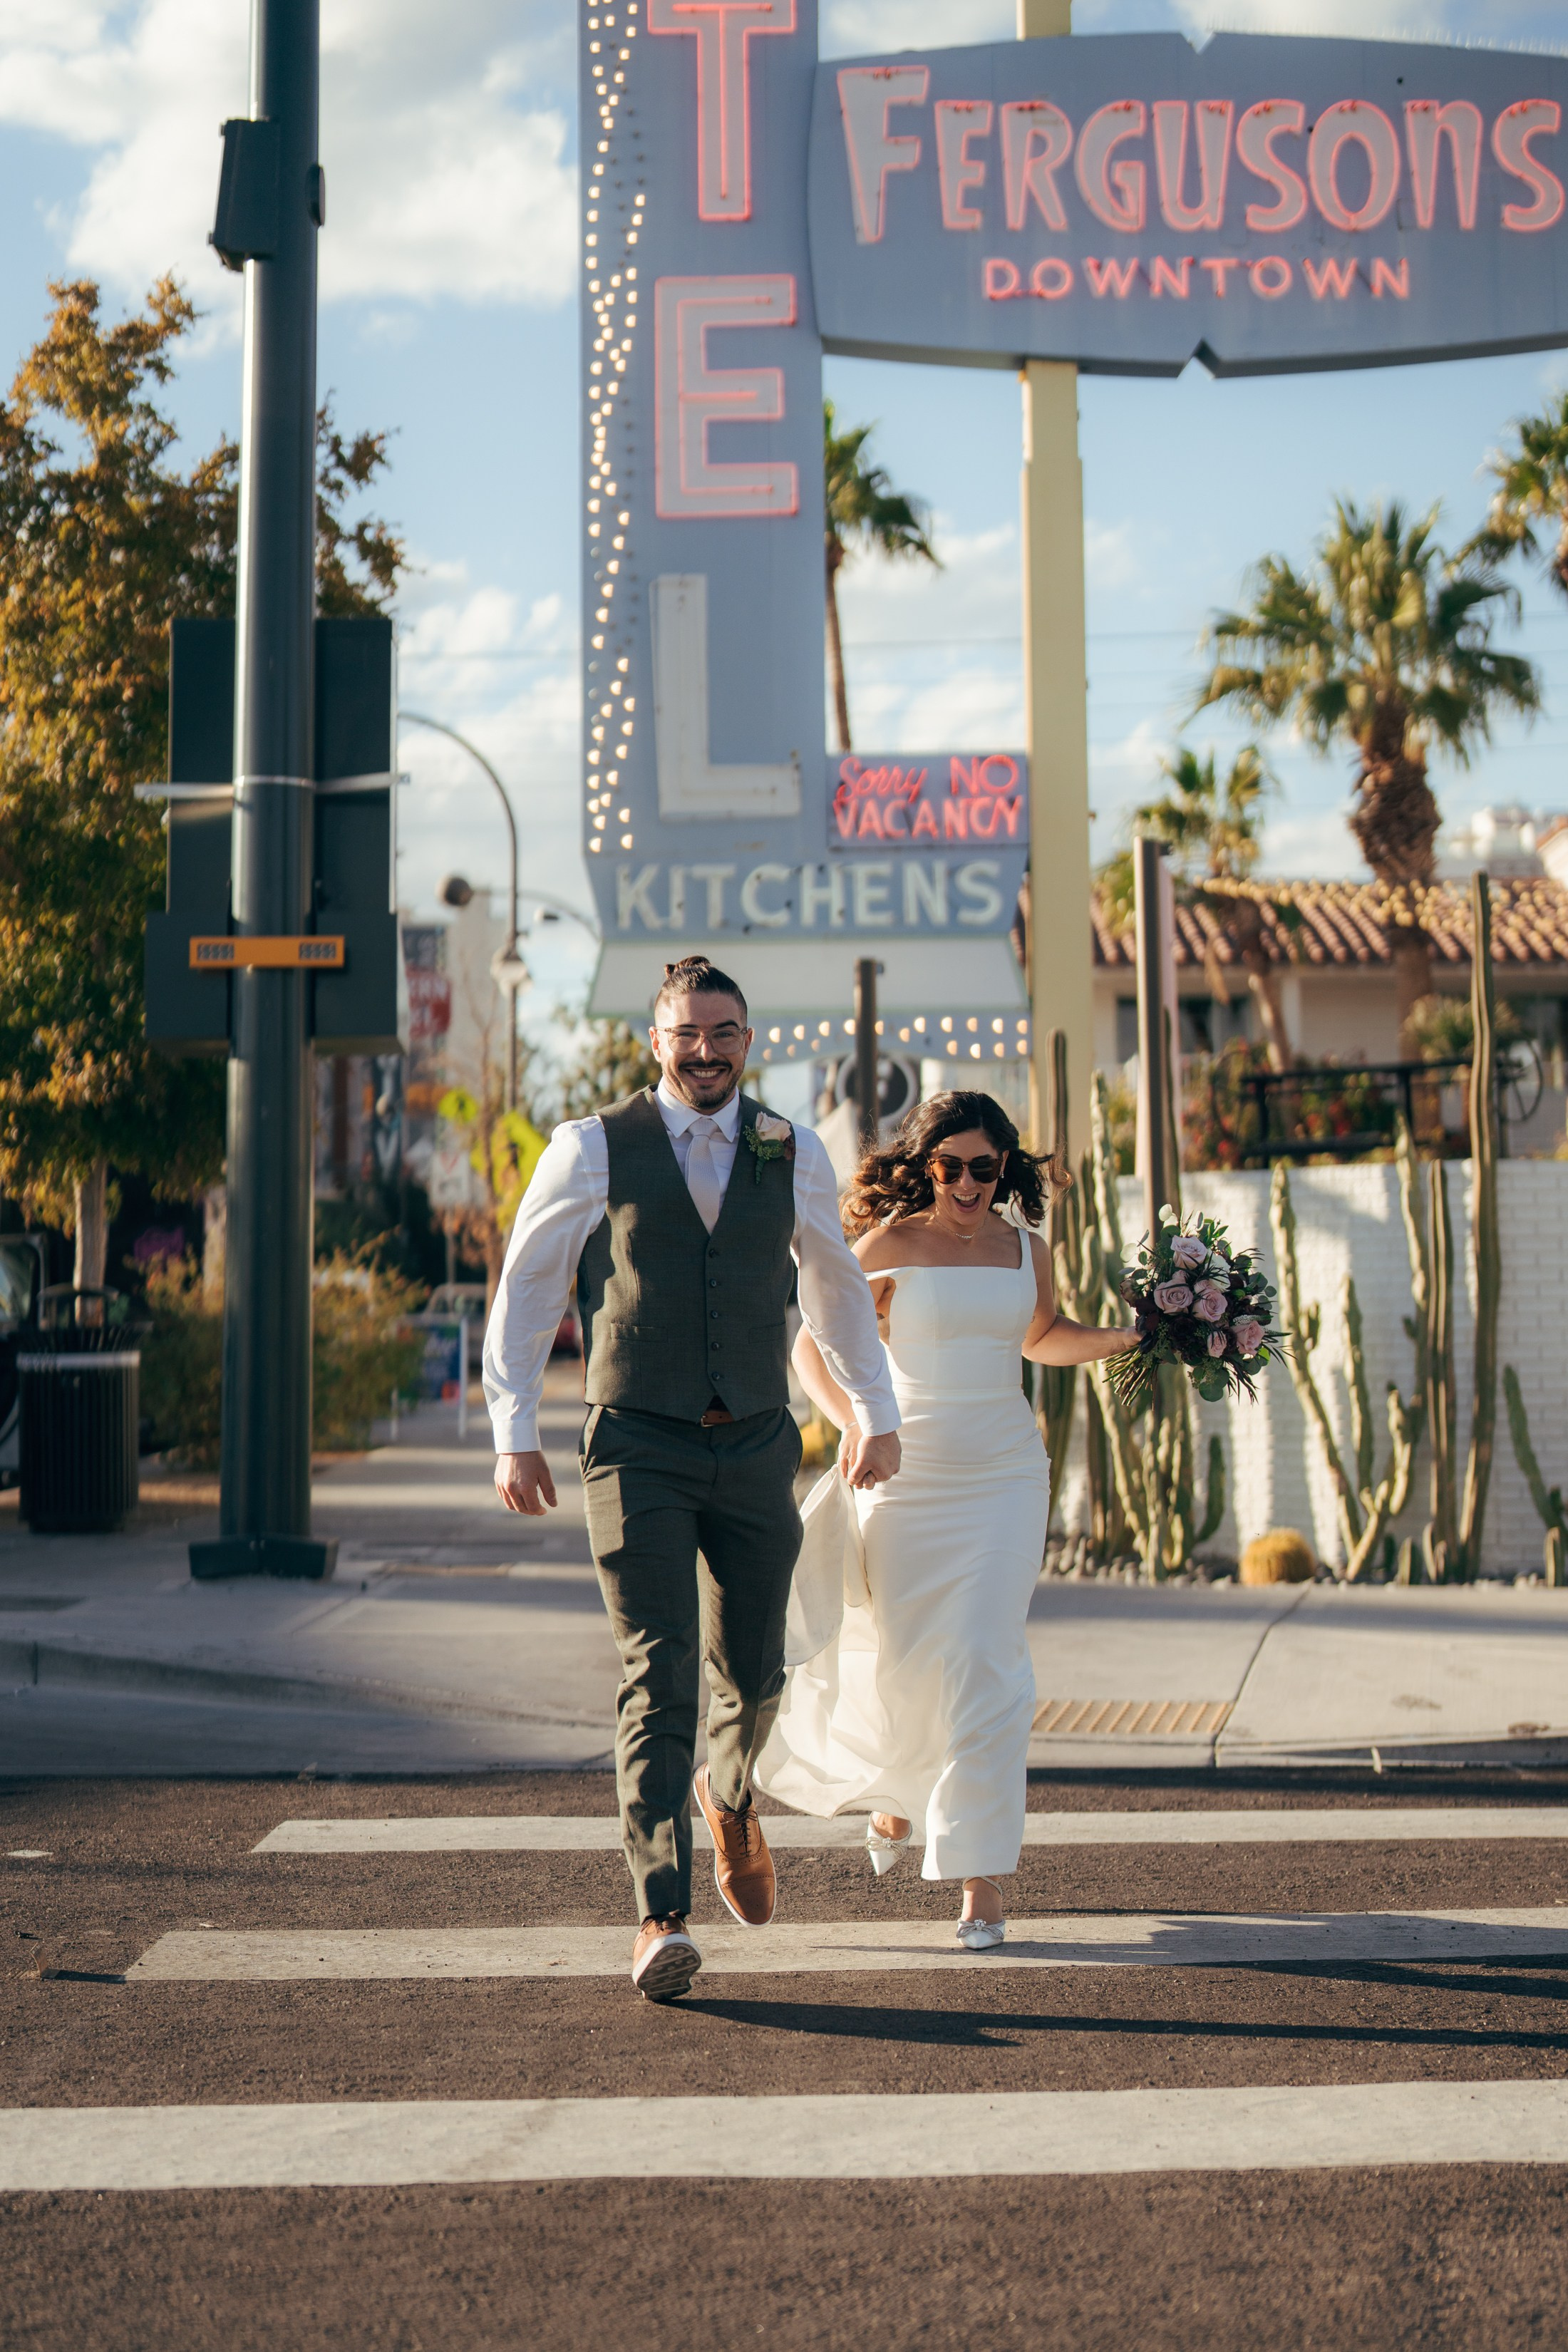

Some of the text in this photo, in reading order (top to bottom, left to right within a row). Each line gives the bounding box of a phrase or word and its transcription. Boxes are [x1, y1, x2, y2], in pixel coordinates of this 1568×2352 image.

[983, 256, 1410, 300] DOWNTOWN
[835, 753, 1020, 804] Sorry NO
[832, 794, 1023, 840] VACANCY
[615, 860, 1004, 929] KITCHENS
